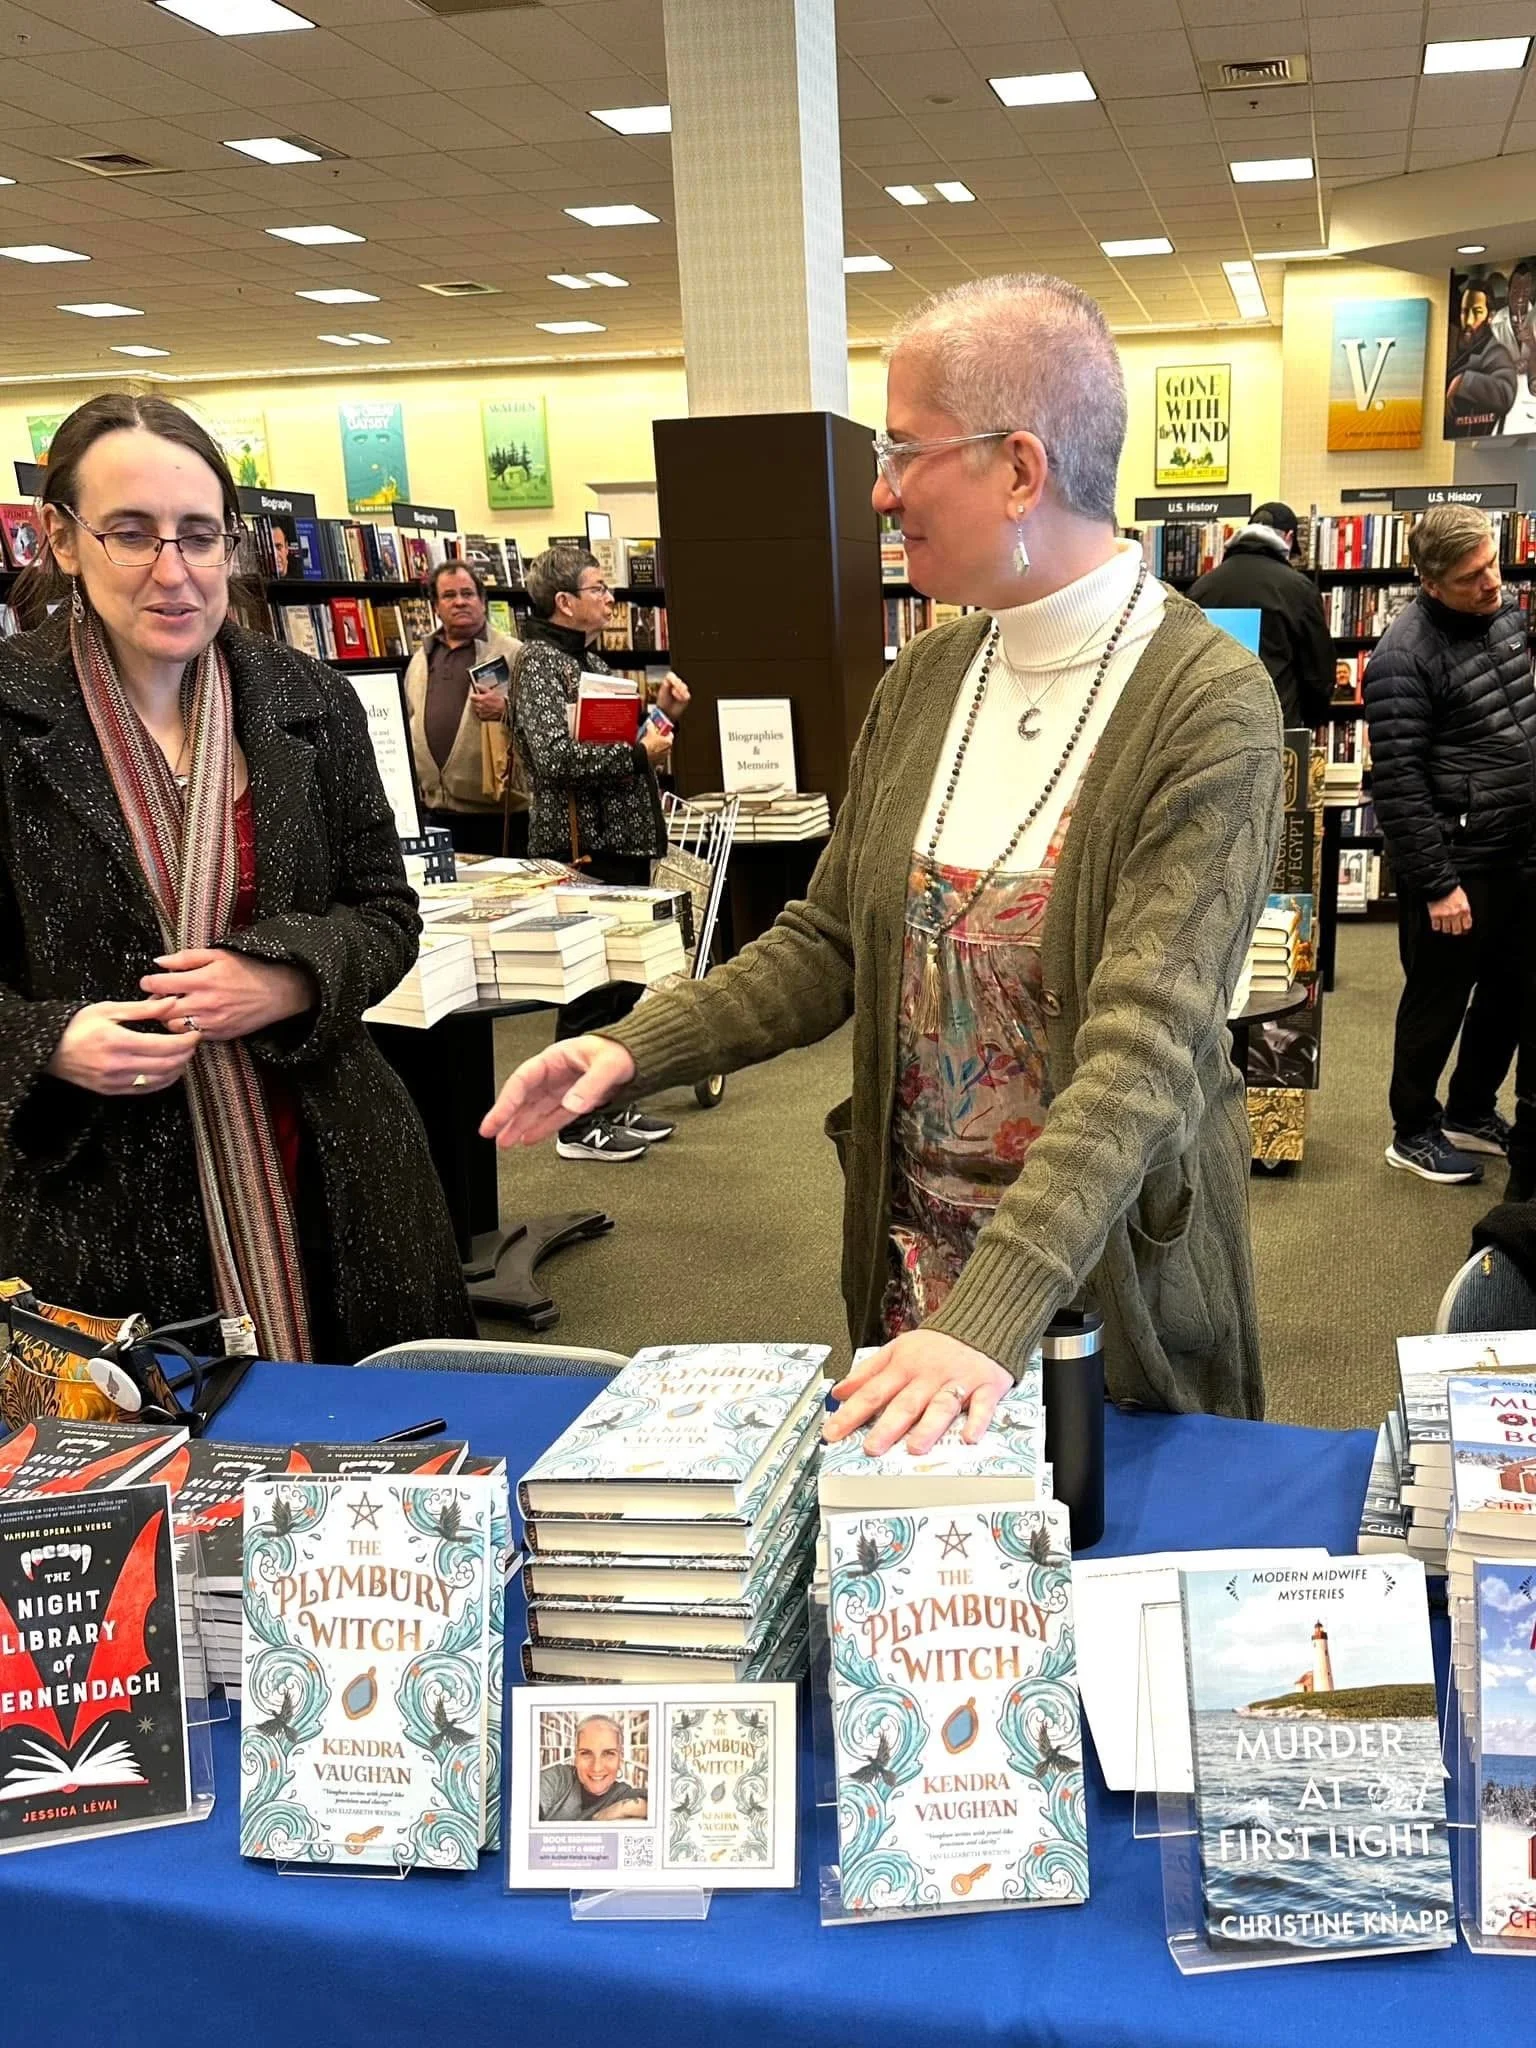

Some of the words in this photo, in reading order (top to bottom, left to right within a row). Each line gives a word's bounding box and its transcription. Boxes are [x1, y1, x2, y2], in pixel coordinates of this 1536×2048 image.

[1166, 374, 1221, 397] GONE
[1166, 398, 1219, 420] WITH
[1456, 413, 1495, 425] MELVILLE
[1171, 421, 1228, 443] WIND
[261, 495, 293, 512] Biography
[1168, 503, 1184, 513] U.S.
[1186, 502, 1219, 513] History
[1428, 493, 1444, 503] U.S.
[1448, 492, 1482, 503] History
[413, 511, 438, 526] Biography
[728, 729, 784, 743] Biographies
[753, 745, 760, 755] &
[737, 759, 779, 770] Memoirs
[1288, 815, 1305, 869] EGYPT
[28, 1453, 91, 1466] NIGHT
[0, 1464, 86, 1480] LIBRARY
[4, 1530, 40, 1541] VAMPIRE
[43, 1527, 71, 1537] OPERA
[74, 1525, 82, 1533] IN
[85, 1521, 112, 1531] VERSE
[347, 1540, 382, 1556] THE
[44, 1571, 71, 1583] THE
[937, 1568, 973, 1586] THE
[1252, 1571, 1308, 1583] MODERN
[1312, 1569, 1367, 1581] MIDWIFE
[272, 1565, 457, 1617] PLYMBURY
[1278, 1588, 1344, 1601] MYSTERIES
[18, 1589, 100, 1619] NIGHT
[298, 1610, 423, 1651] WITCH
[861, 1593, 1052, 1657] PLYMBURY
[2, 1620, 117, 1655] LIBRARY
[53, 1654, 75, 1678] of
[891, 1645, 1021, 1683] WITCH
[322, 1737, 405, 1759] KENDRA
[683, 1739, 757, 1760] PLYMBURY
[1235, 1723, 1405, 1761] MURDER
[314, 1763, 412, 1785] VAUGHAN
[693, 1759, 744, 1775] WITCH
[923, 1772, 1011, 1794] KENDRA
[1299, 1776, 1346, 1810] AT
[22, 1805, 77, 1823] JESSICA
[83, 1800, 118, 1813] LÉVAI
[915, 1799, 1018, 1822] VAUGHAN
[1219, 1827, 1316, 1861] FIRST
[1329, 1823, 1434, 1858] LIGHT
[1221, 1910, 1355, 1938] CHRISTINE
[1364, 1909, 1449, 1934] KNAPP
